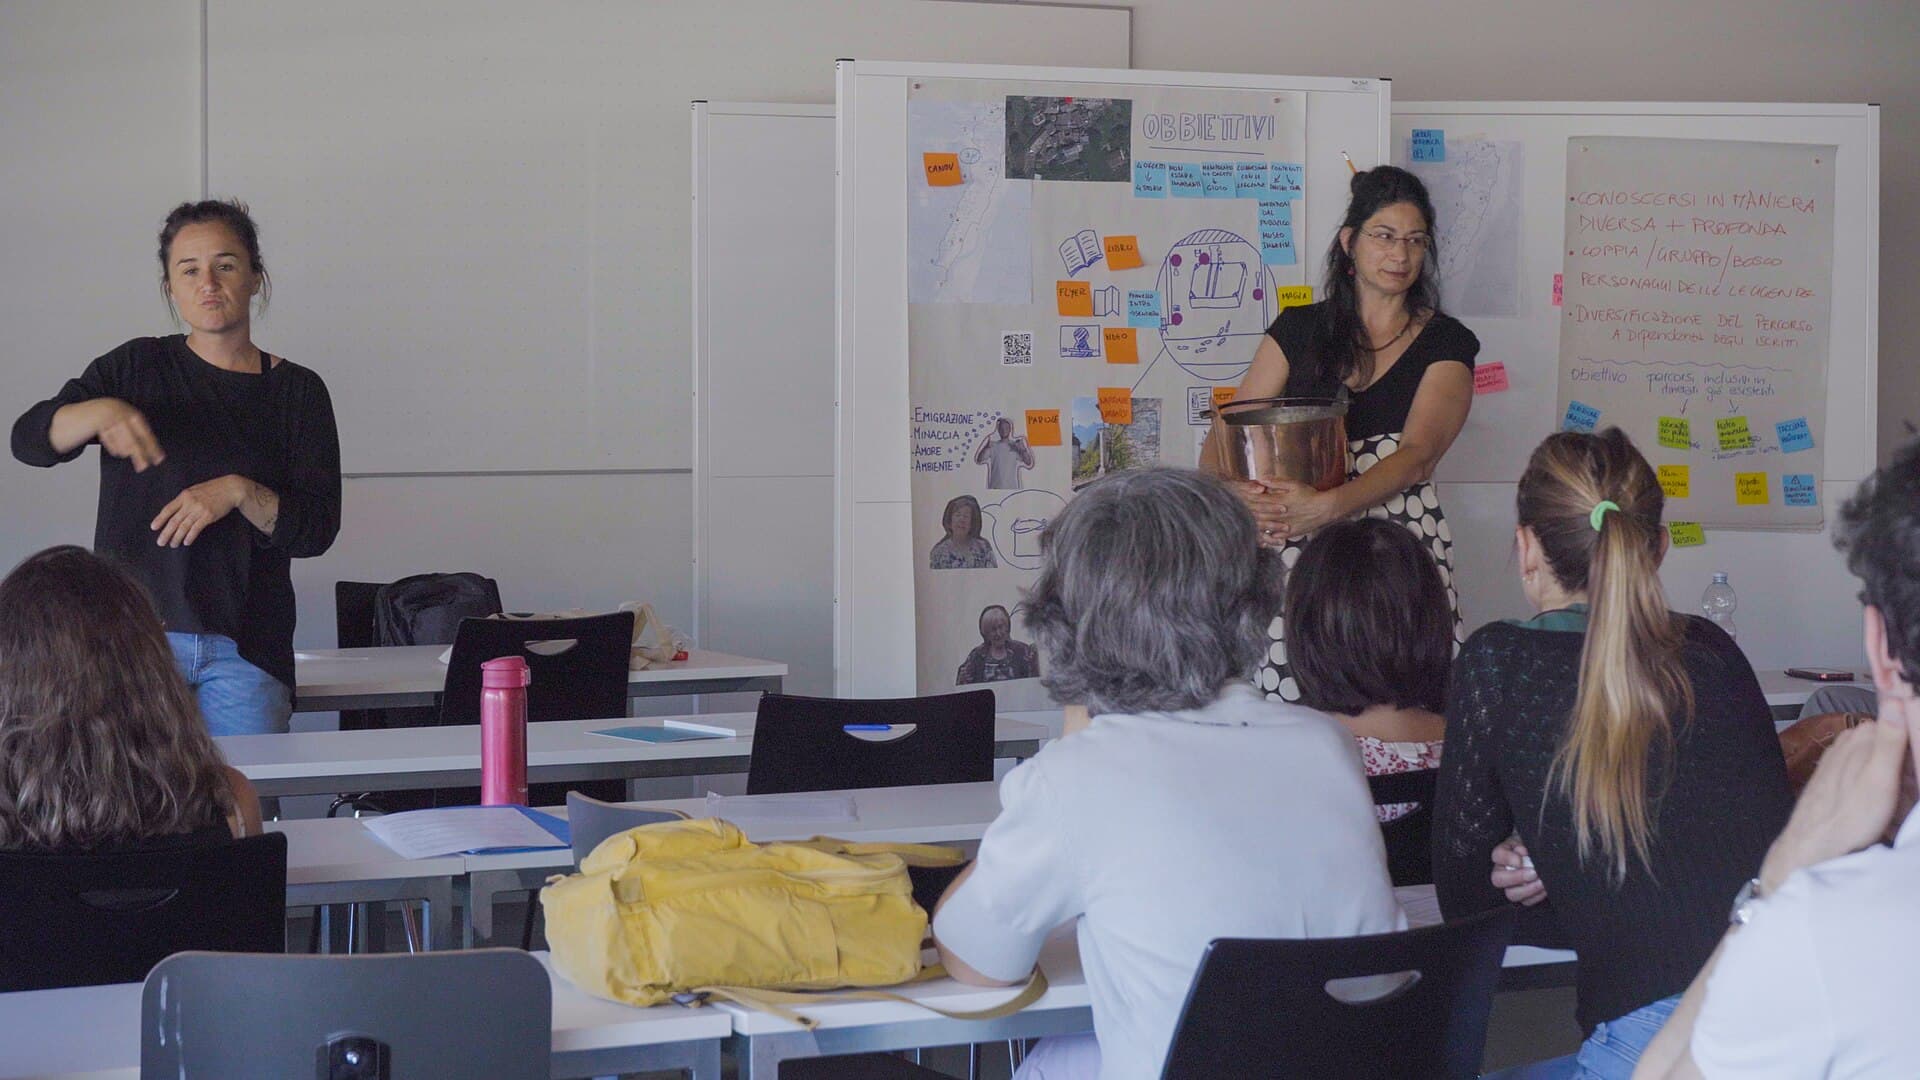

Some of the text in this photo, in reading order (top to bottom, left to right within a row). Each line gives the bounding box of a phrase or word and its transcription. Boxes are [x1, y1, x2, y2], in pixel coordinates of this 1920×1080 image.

[1143, 113, 1275, 142] OBBIETTIVI
[1577, 190, 1816, 214] CONOSCERSI IN MANIERA
[1579, 214, 1656, 233] DIVERSA
[1691, 216, 1787, 236] PROFONDA
[1107, 243, 1133, 253] LIBRO
[1582, 245, 1639, 258] COPPIA
[1580, 271, 1672, 290] PERSONAGGI
[1678, 279, 1721, 296] DELLE
[1728, 286, 1816, 299] LEGGENDE
[1059, 287, 1087, 298] FLYER
[1717, 313, 1744, 329] DEL
[1754, 313, 1813, 331] PERCORSO
[914, 407, 974, 425] EMIGRAZIONE
[1027, 415, 1059, 425] PAROLE
[914, 427, 960, 441] MINACCIA
[914, 443, 942, 457] AMORE
[915, 459, 953, 472] AMBIENTE
